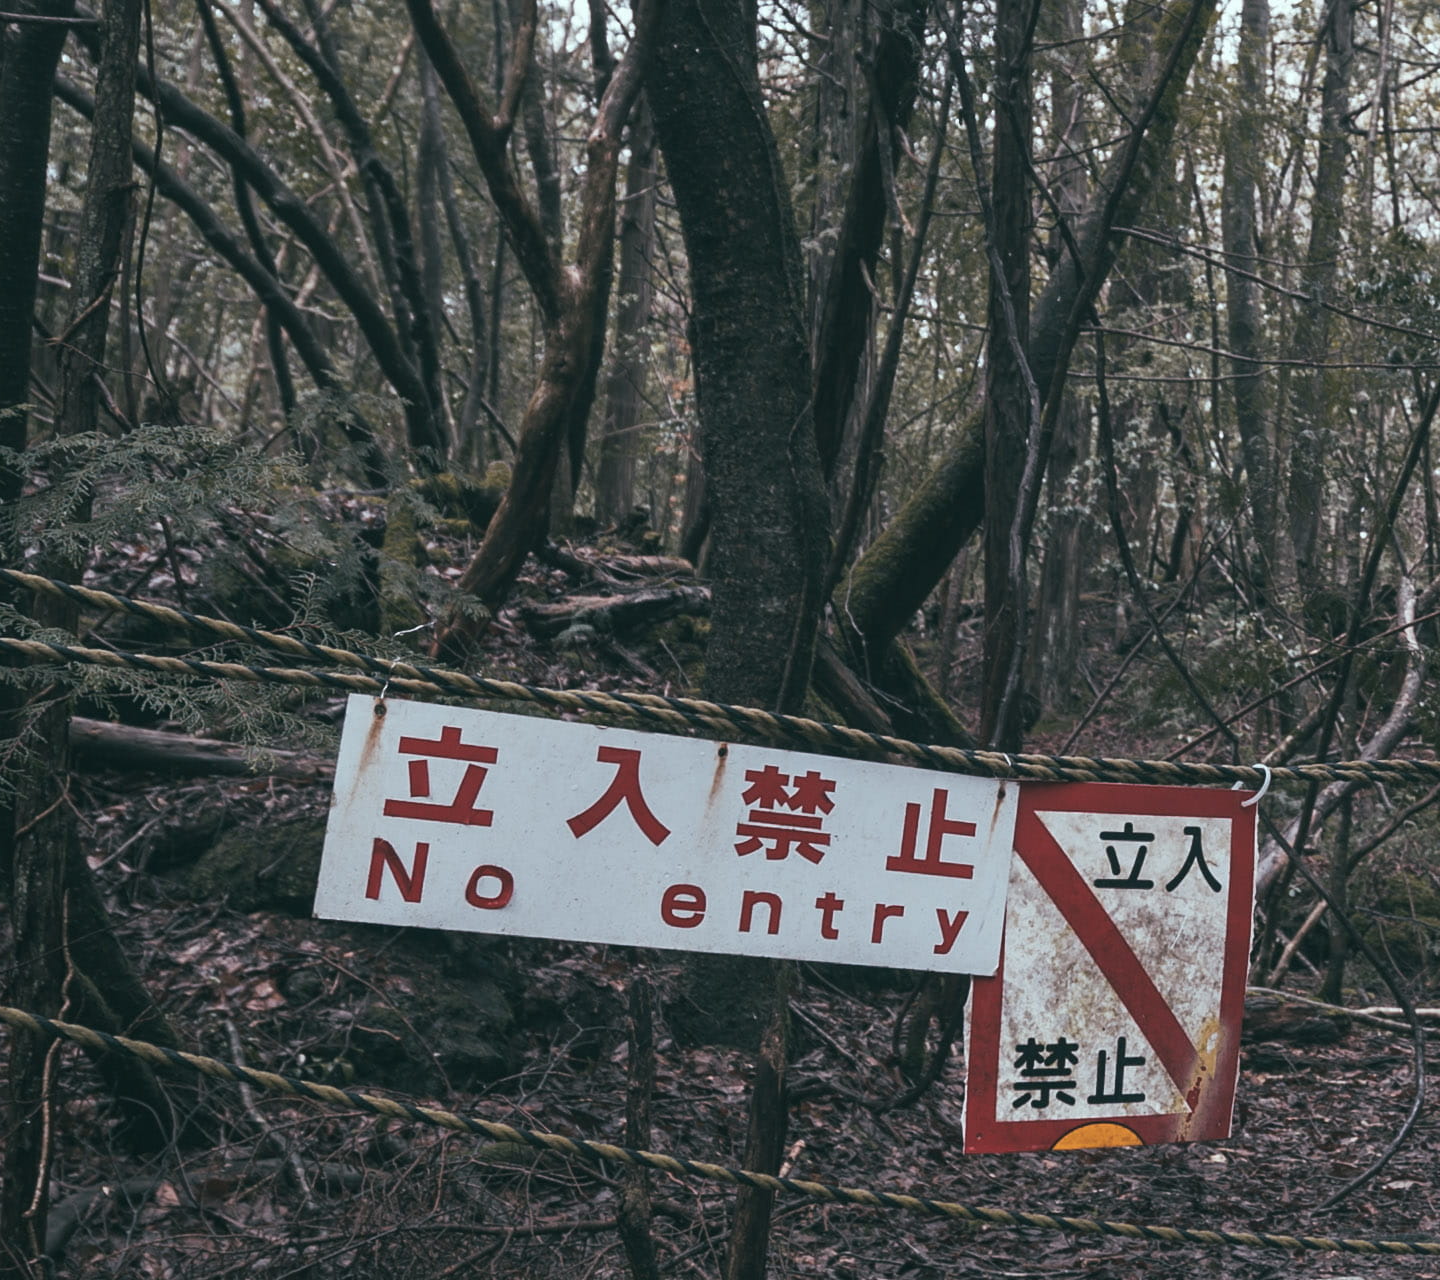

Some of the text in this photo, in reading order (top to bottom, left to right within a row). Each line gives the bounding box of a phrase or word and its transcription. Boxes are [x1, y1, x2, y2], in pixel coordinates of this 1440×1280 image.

[384, 726, 977, 880] 立入禁止
[364, 836, 971, 955] No entry
[1094, 822, 1222, 894] 立入
[1012, 1036, 1146, 1110] 禁止
